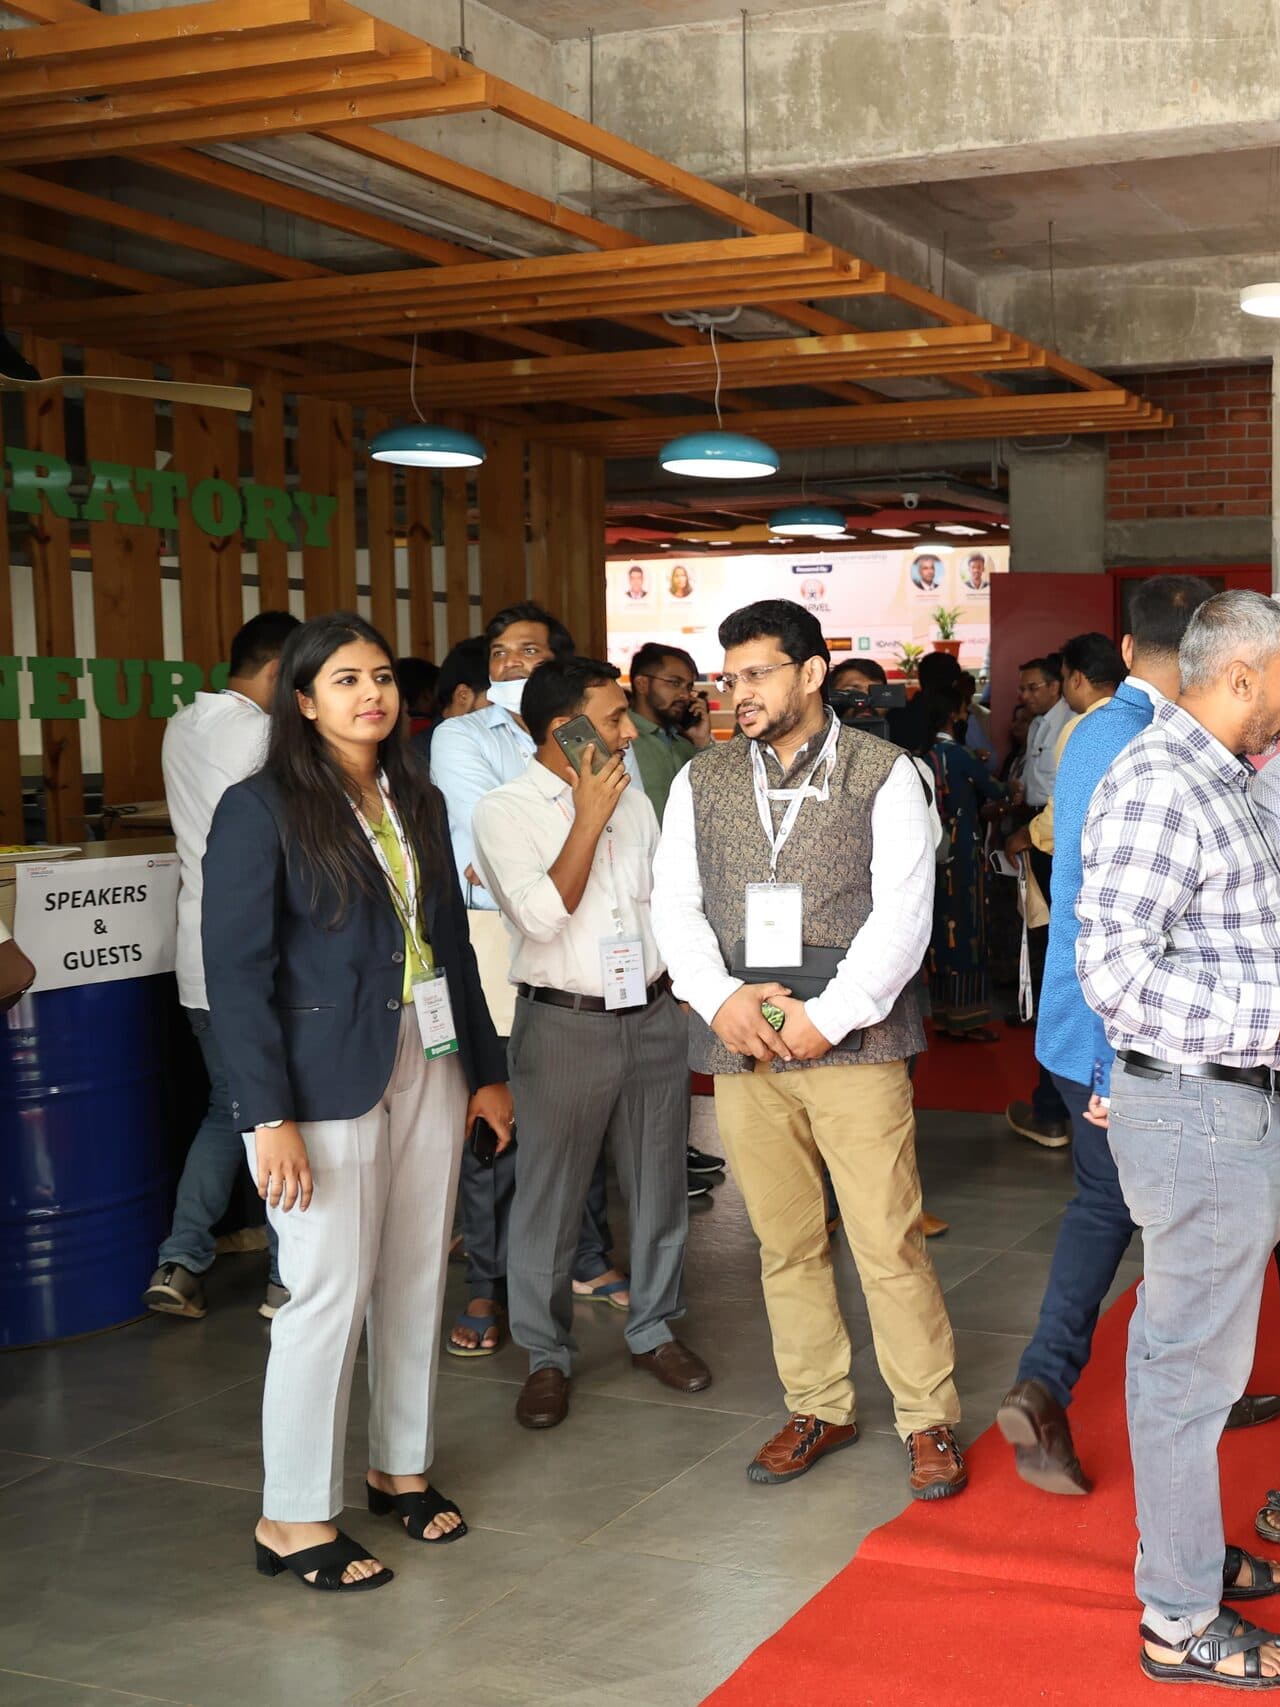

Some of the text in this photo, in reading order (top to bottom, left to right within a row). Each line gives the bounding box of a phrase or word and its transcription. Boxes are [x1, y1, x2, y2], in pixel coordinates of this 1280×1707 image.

[0, 446, 339, 548] RATORY
[44, 884, 148, 912] SPEAKERS
[94, 918, 108, 935] &
[63, 943, 143, 971] GUESTS
